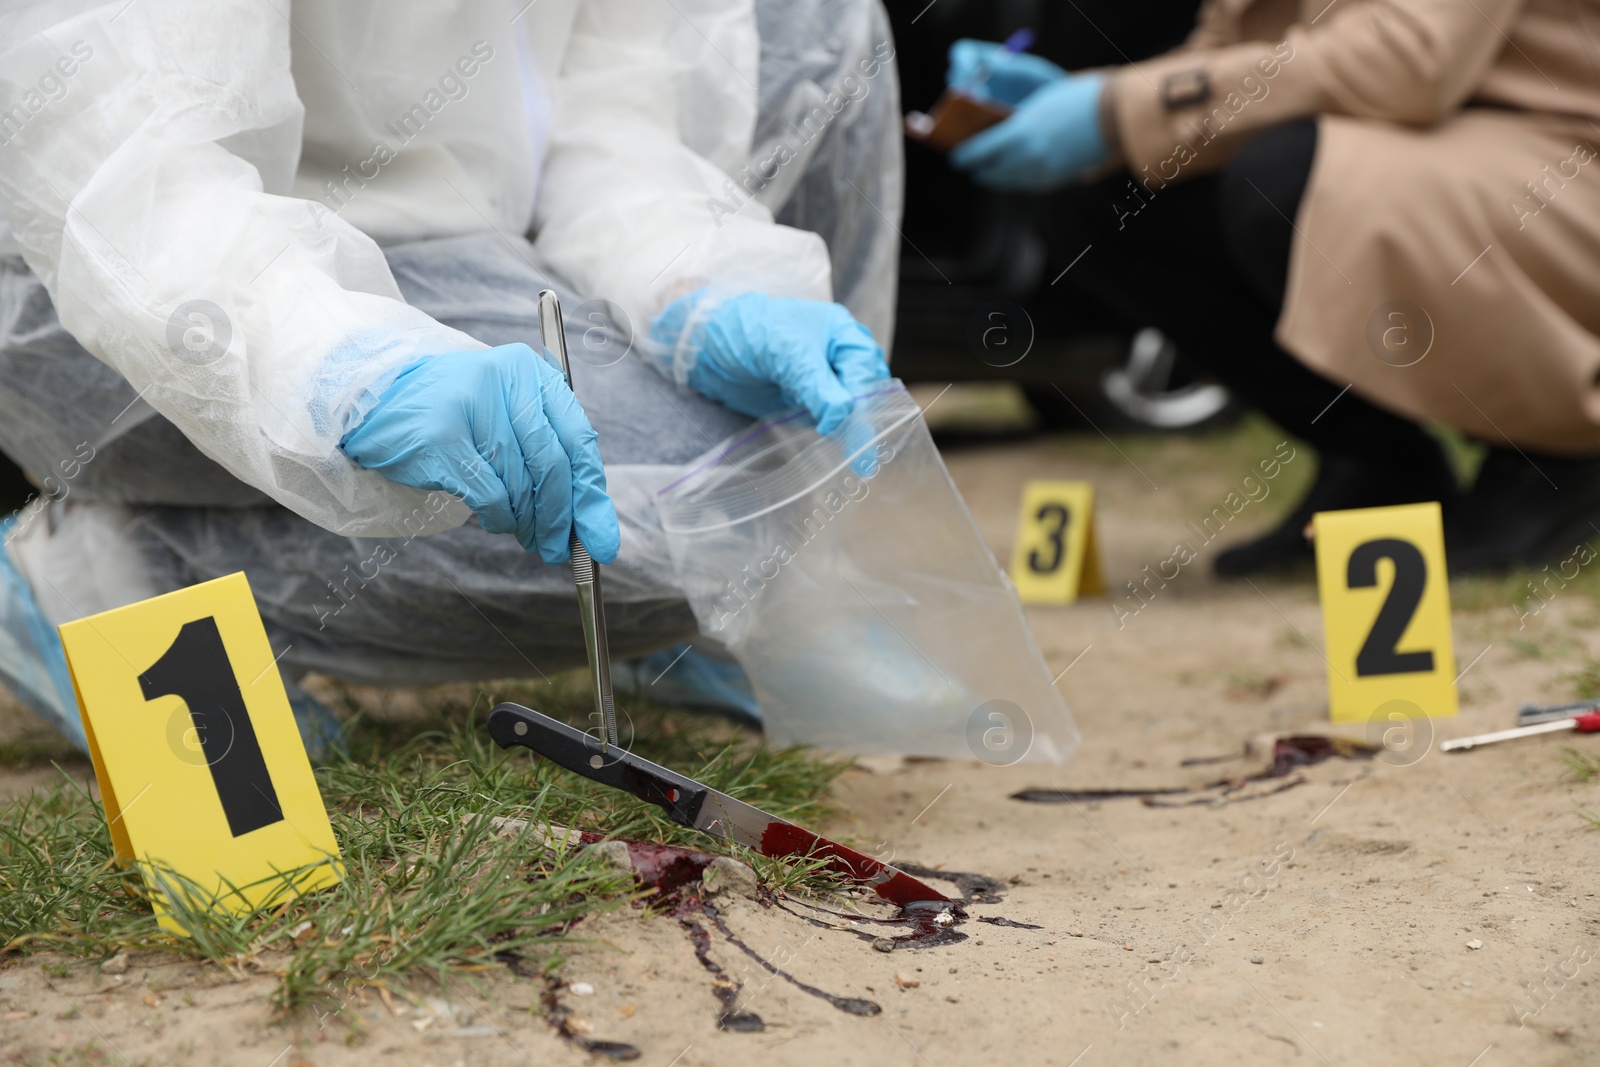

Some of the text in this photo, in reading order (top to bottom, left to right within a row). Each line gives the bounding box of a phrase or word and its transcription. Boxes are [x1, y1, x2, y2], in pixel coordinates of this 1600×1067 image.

[1028, 503, 1070, 576] 3
[1346, 538, 1435, 678] 2
[137, 616, 284, 838] 1
